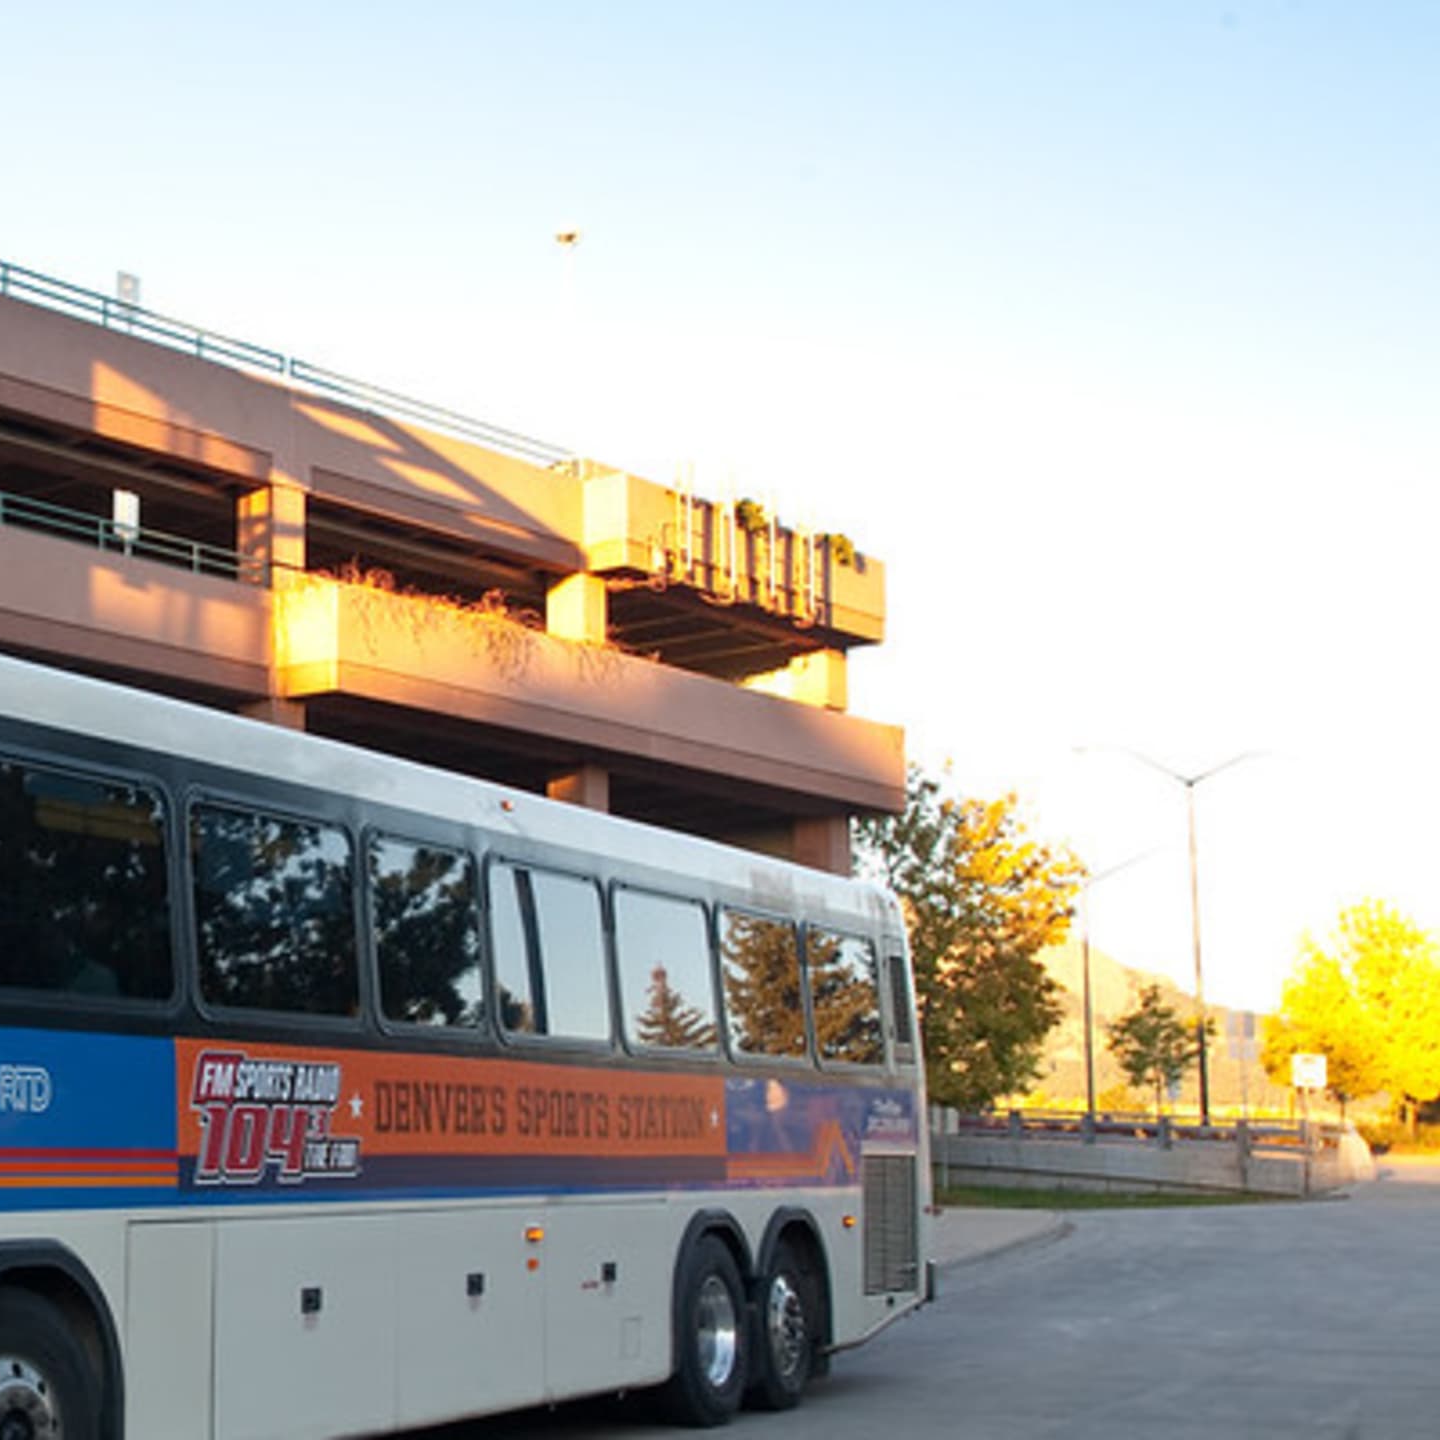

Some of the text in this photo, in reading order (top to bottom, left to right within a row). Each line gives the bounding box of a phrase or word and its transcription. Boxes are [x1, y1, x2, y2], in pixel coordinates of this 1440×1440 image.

[200, 1061, 339, 1101] FM SPORTS RADIO
[515, 1085, 611, 1139] SPORTS
[616, 1093, 706, 1140] STATION
